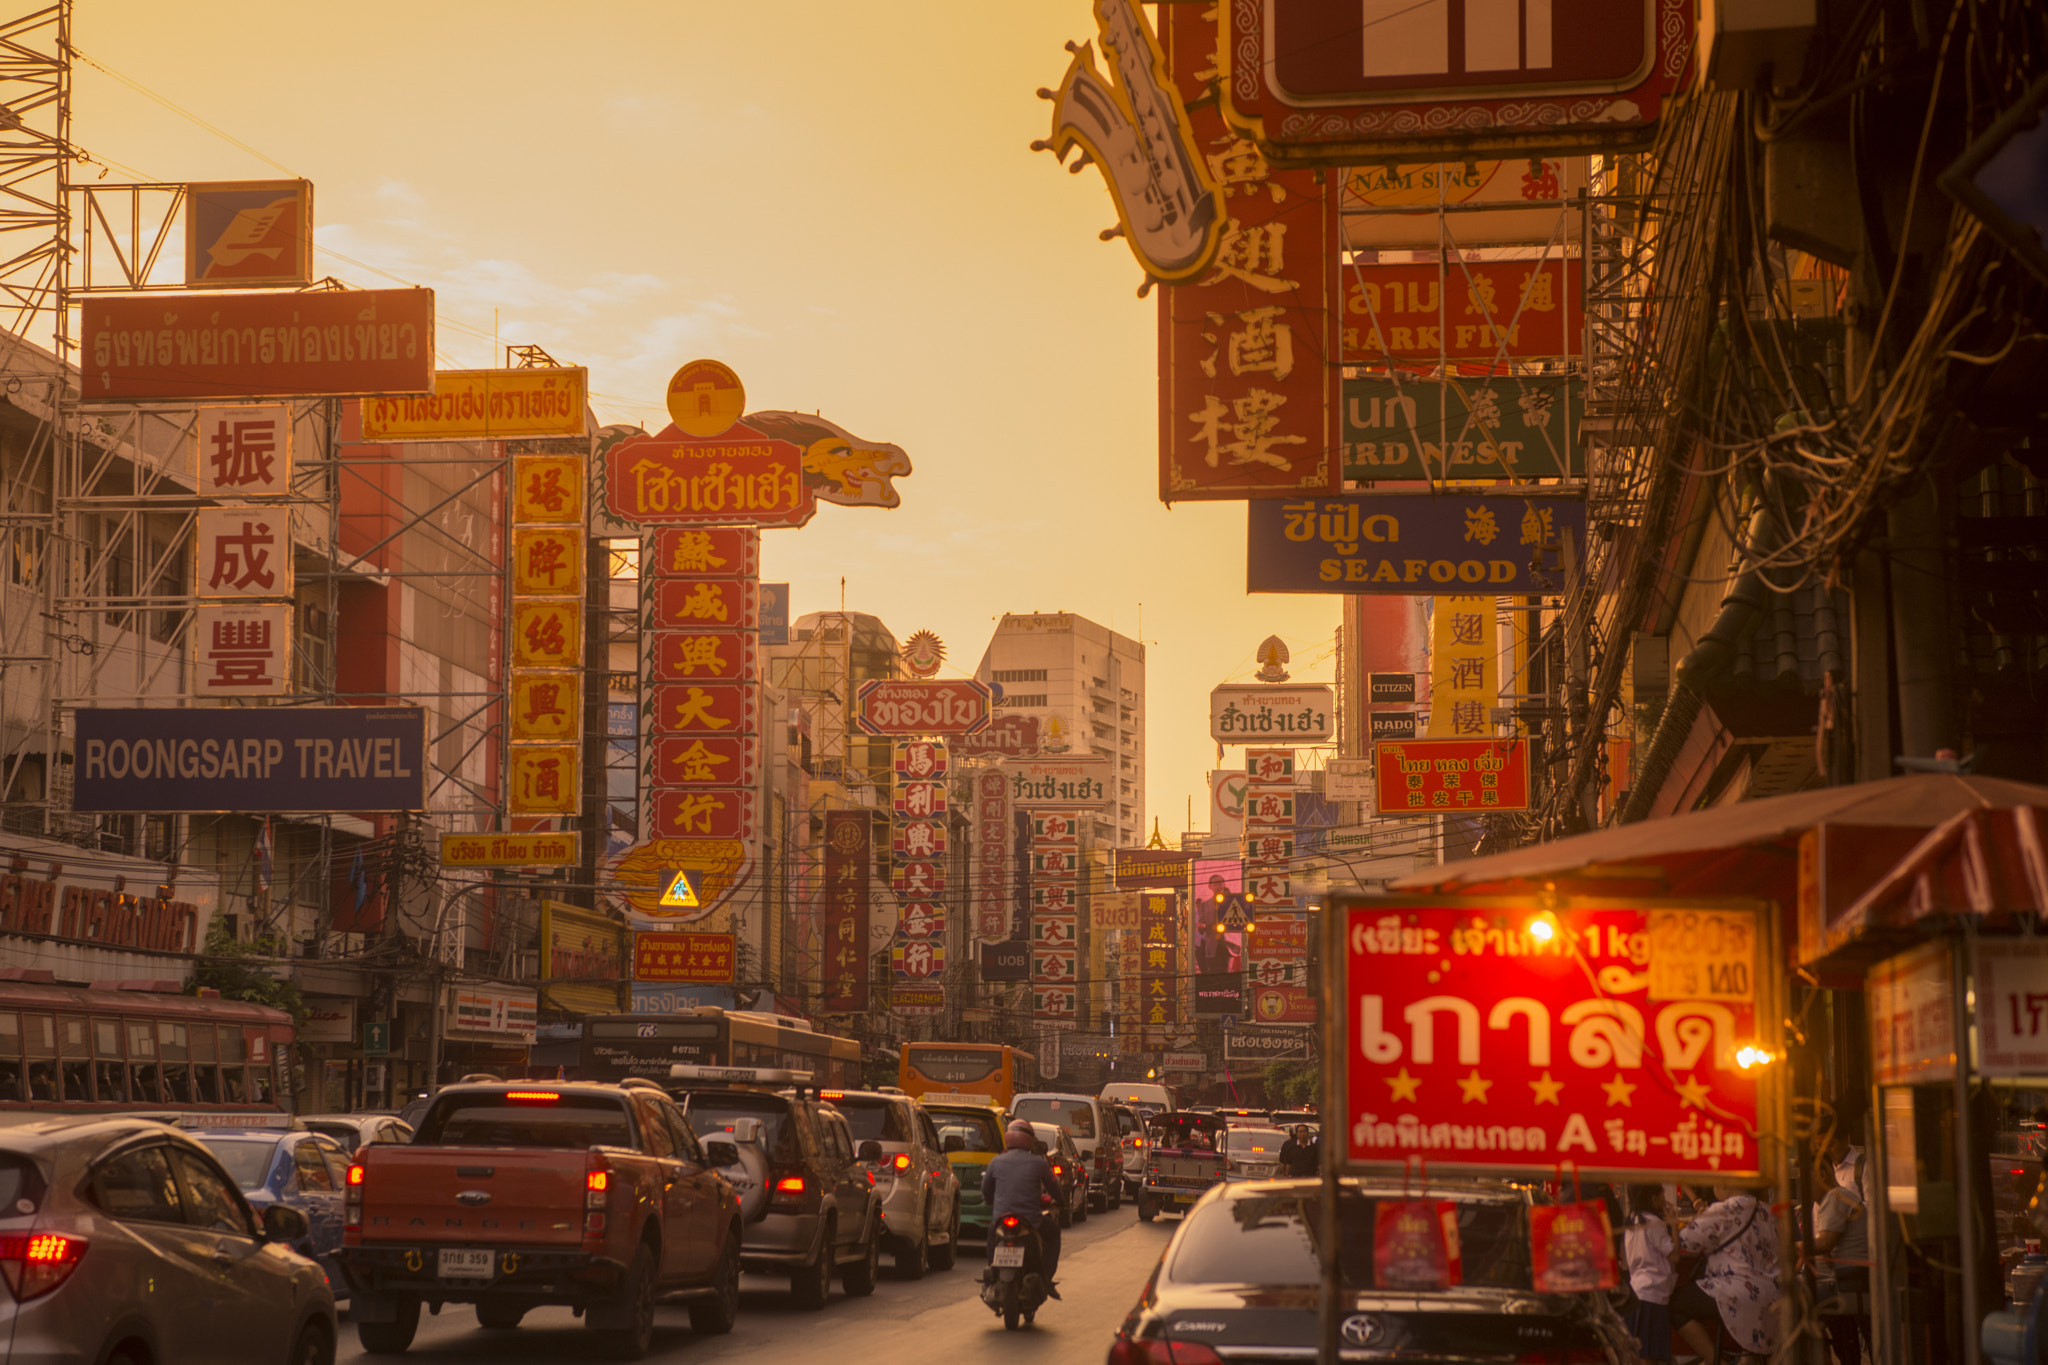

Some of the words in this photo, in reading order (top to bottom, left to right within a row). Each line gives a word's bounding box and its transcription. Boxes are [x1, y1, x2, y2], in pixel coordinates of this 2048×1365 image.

[1354, 171, 1412, 190] NAM
[1454, 323, 1520, 349] FIN
[1421, 440, 1524, 465] NEST
[208, 420, 276, 686] 振成豐
[1319, 559, 1518, 584] SEAFOOD
[1371, 683, 1413, 693] CITIZEN
[1373, 720, 1414, 732] RADO
[85, 738, 284, 780] ROONGSARP
[294, 736, 412, 779] TRAVEL
[1396, 754, 1430, 773] ไทย
[1434, 758, 1469, 773] หลง
[998, 956, 1025, 967] UOB
[637, 1023, 658, 1038] 73
[1556, 1113, 1598, 1153] A
